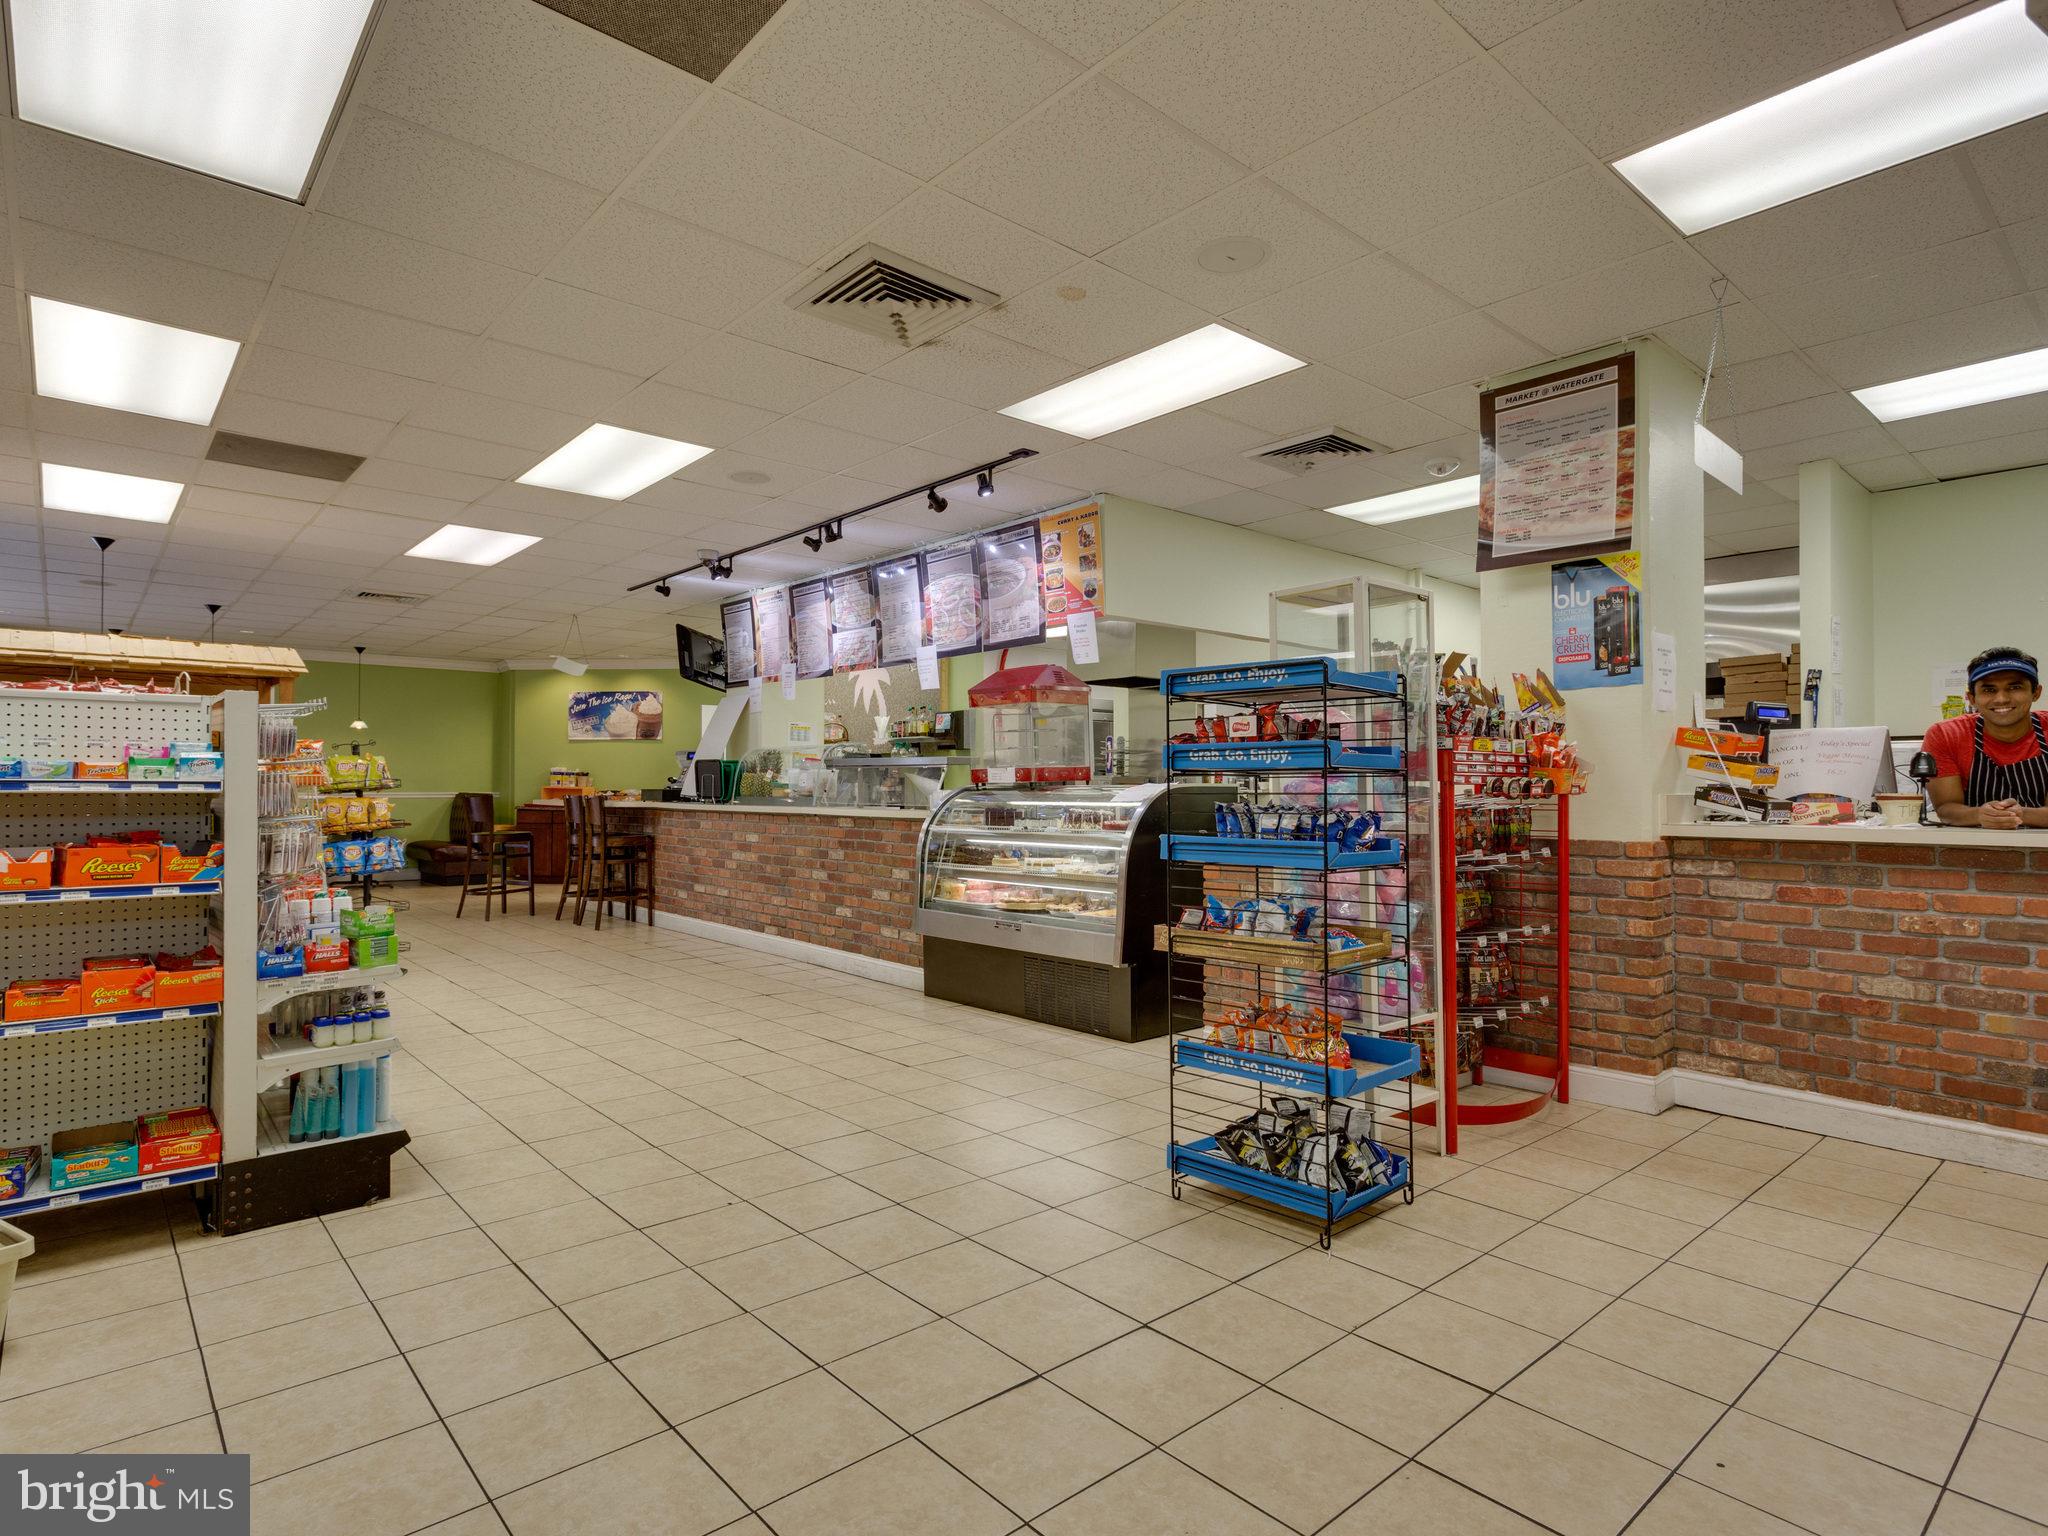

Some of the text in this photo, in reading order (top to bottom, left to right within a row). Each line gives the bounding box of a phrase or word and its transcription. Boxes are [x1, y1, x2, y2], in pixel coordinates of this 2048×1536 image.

[1505, 373, 1605, 404] MARKET @ WATERGATE
[1621, 554, 1639, 570] NEW
[1553, 582, 1592, 609] blu
[1554, 633, 1591, 646] CHERRY
[1556, 643, 1590, 654] CRUSH
[1558, 654, 1589, 662] DISPOSABLES
[1189, 747, 1292, 764] Grab. Go. Enjoy.
[87, 766, 117, 775] Trident
[1792, 809, 1831, 822] Brownie
[80, 857, 143, 874] Reese's
[266, 955, 294, 965] HALLS
[315, 950, 341, 960] HALLS
[1204, 1051, 1307, 1085] Grab. Go. Enjoy.
[159, 1142, 202, 1157] Starburst
[66, 1157, 109, 1173] Starburst
